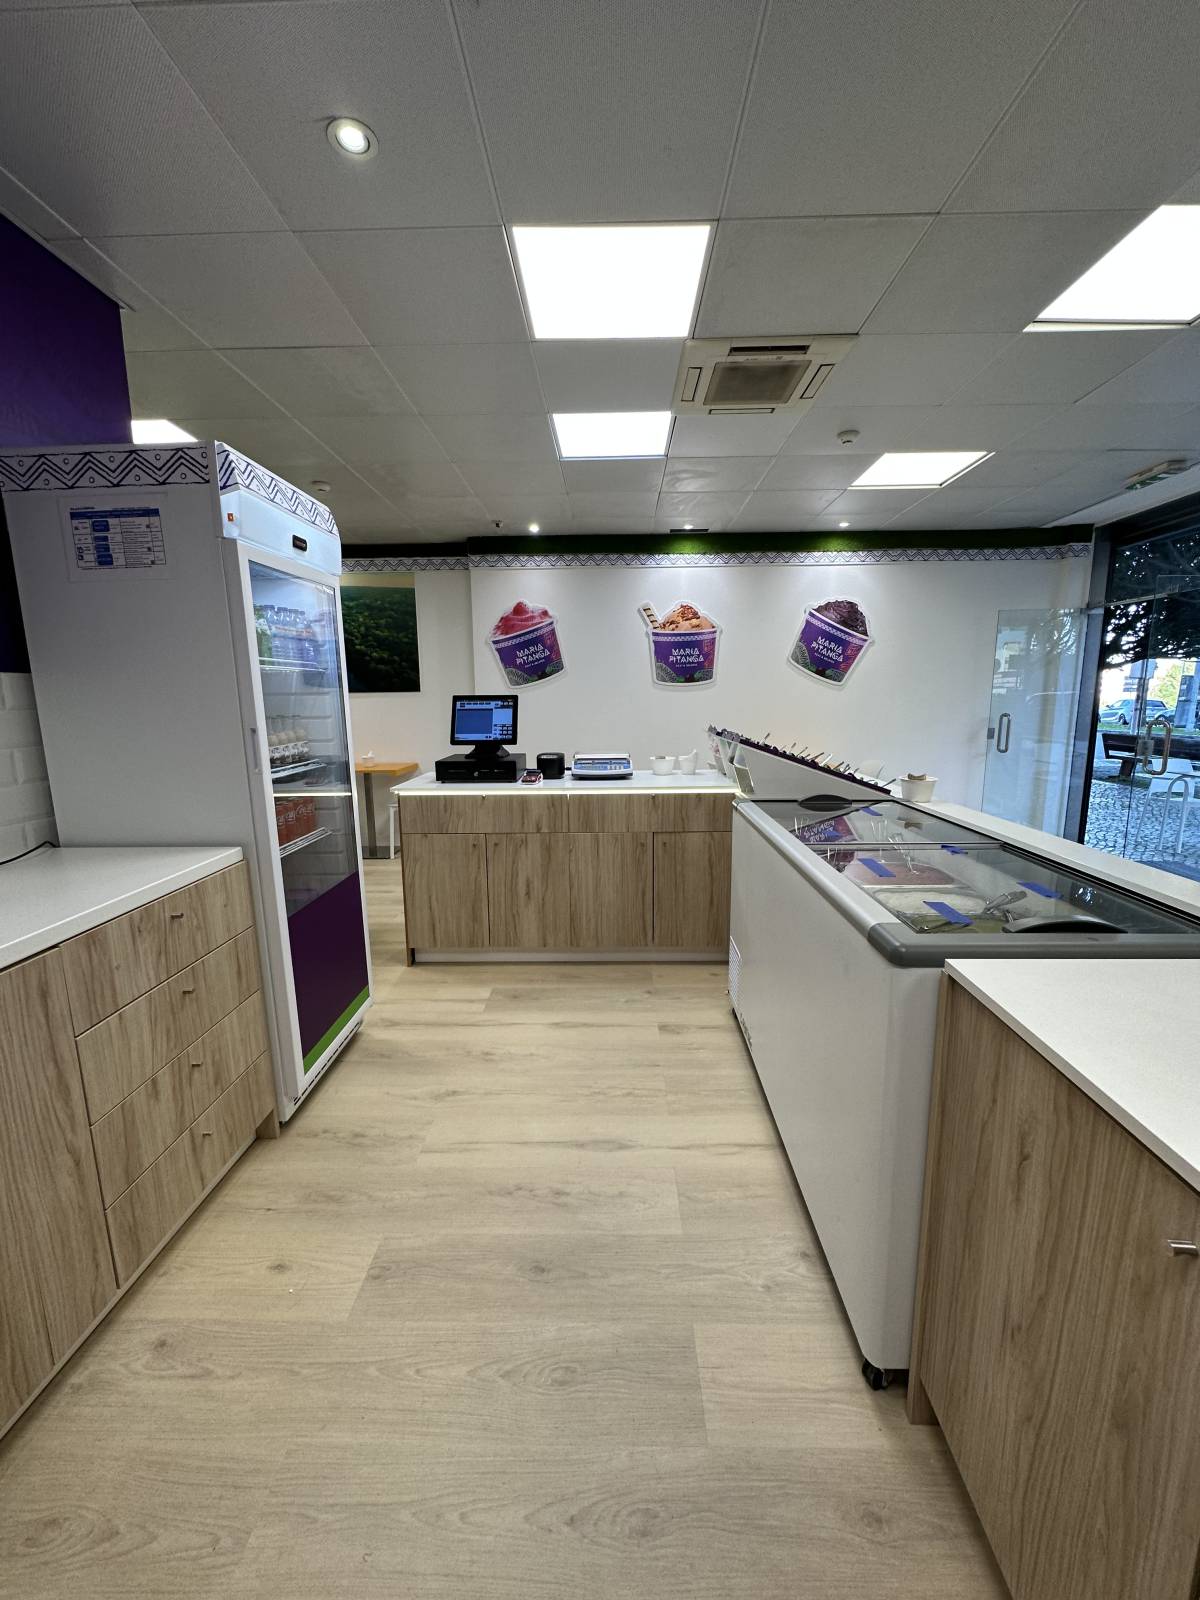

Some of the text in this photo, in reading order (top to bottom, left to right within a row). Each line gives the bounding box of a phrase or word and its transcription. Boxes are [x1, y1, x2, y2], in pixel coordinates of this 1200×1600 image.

[516, 643, 544, 658] MARIA
[672, 648, 700, 656] MARIA
[811, 641, 843, 662] PITANGA
[817, 636, 842, 653] MARIA
[515, 649, 550, 665] PITANGA
[669, 655, 704, 663] PITANGA
